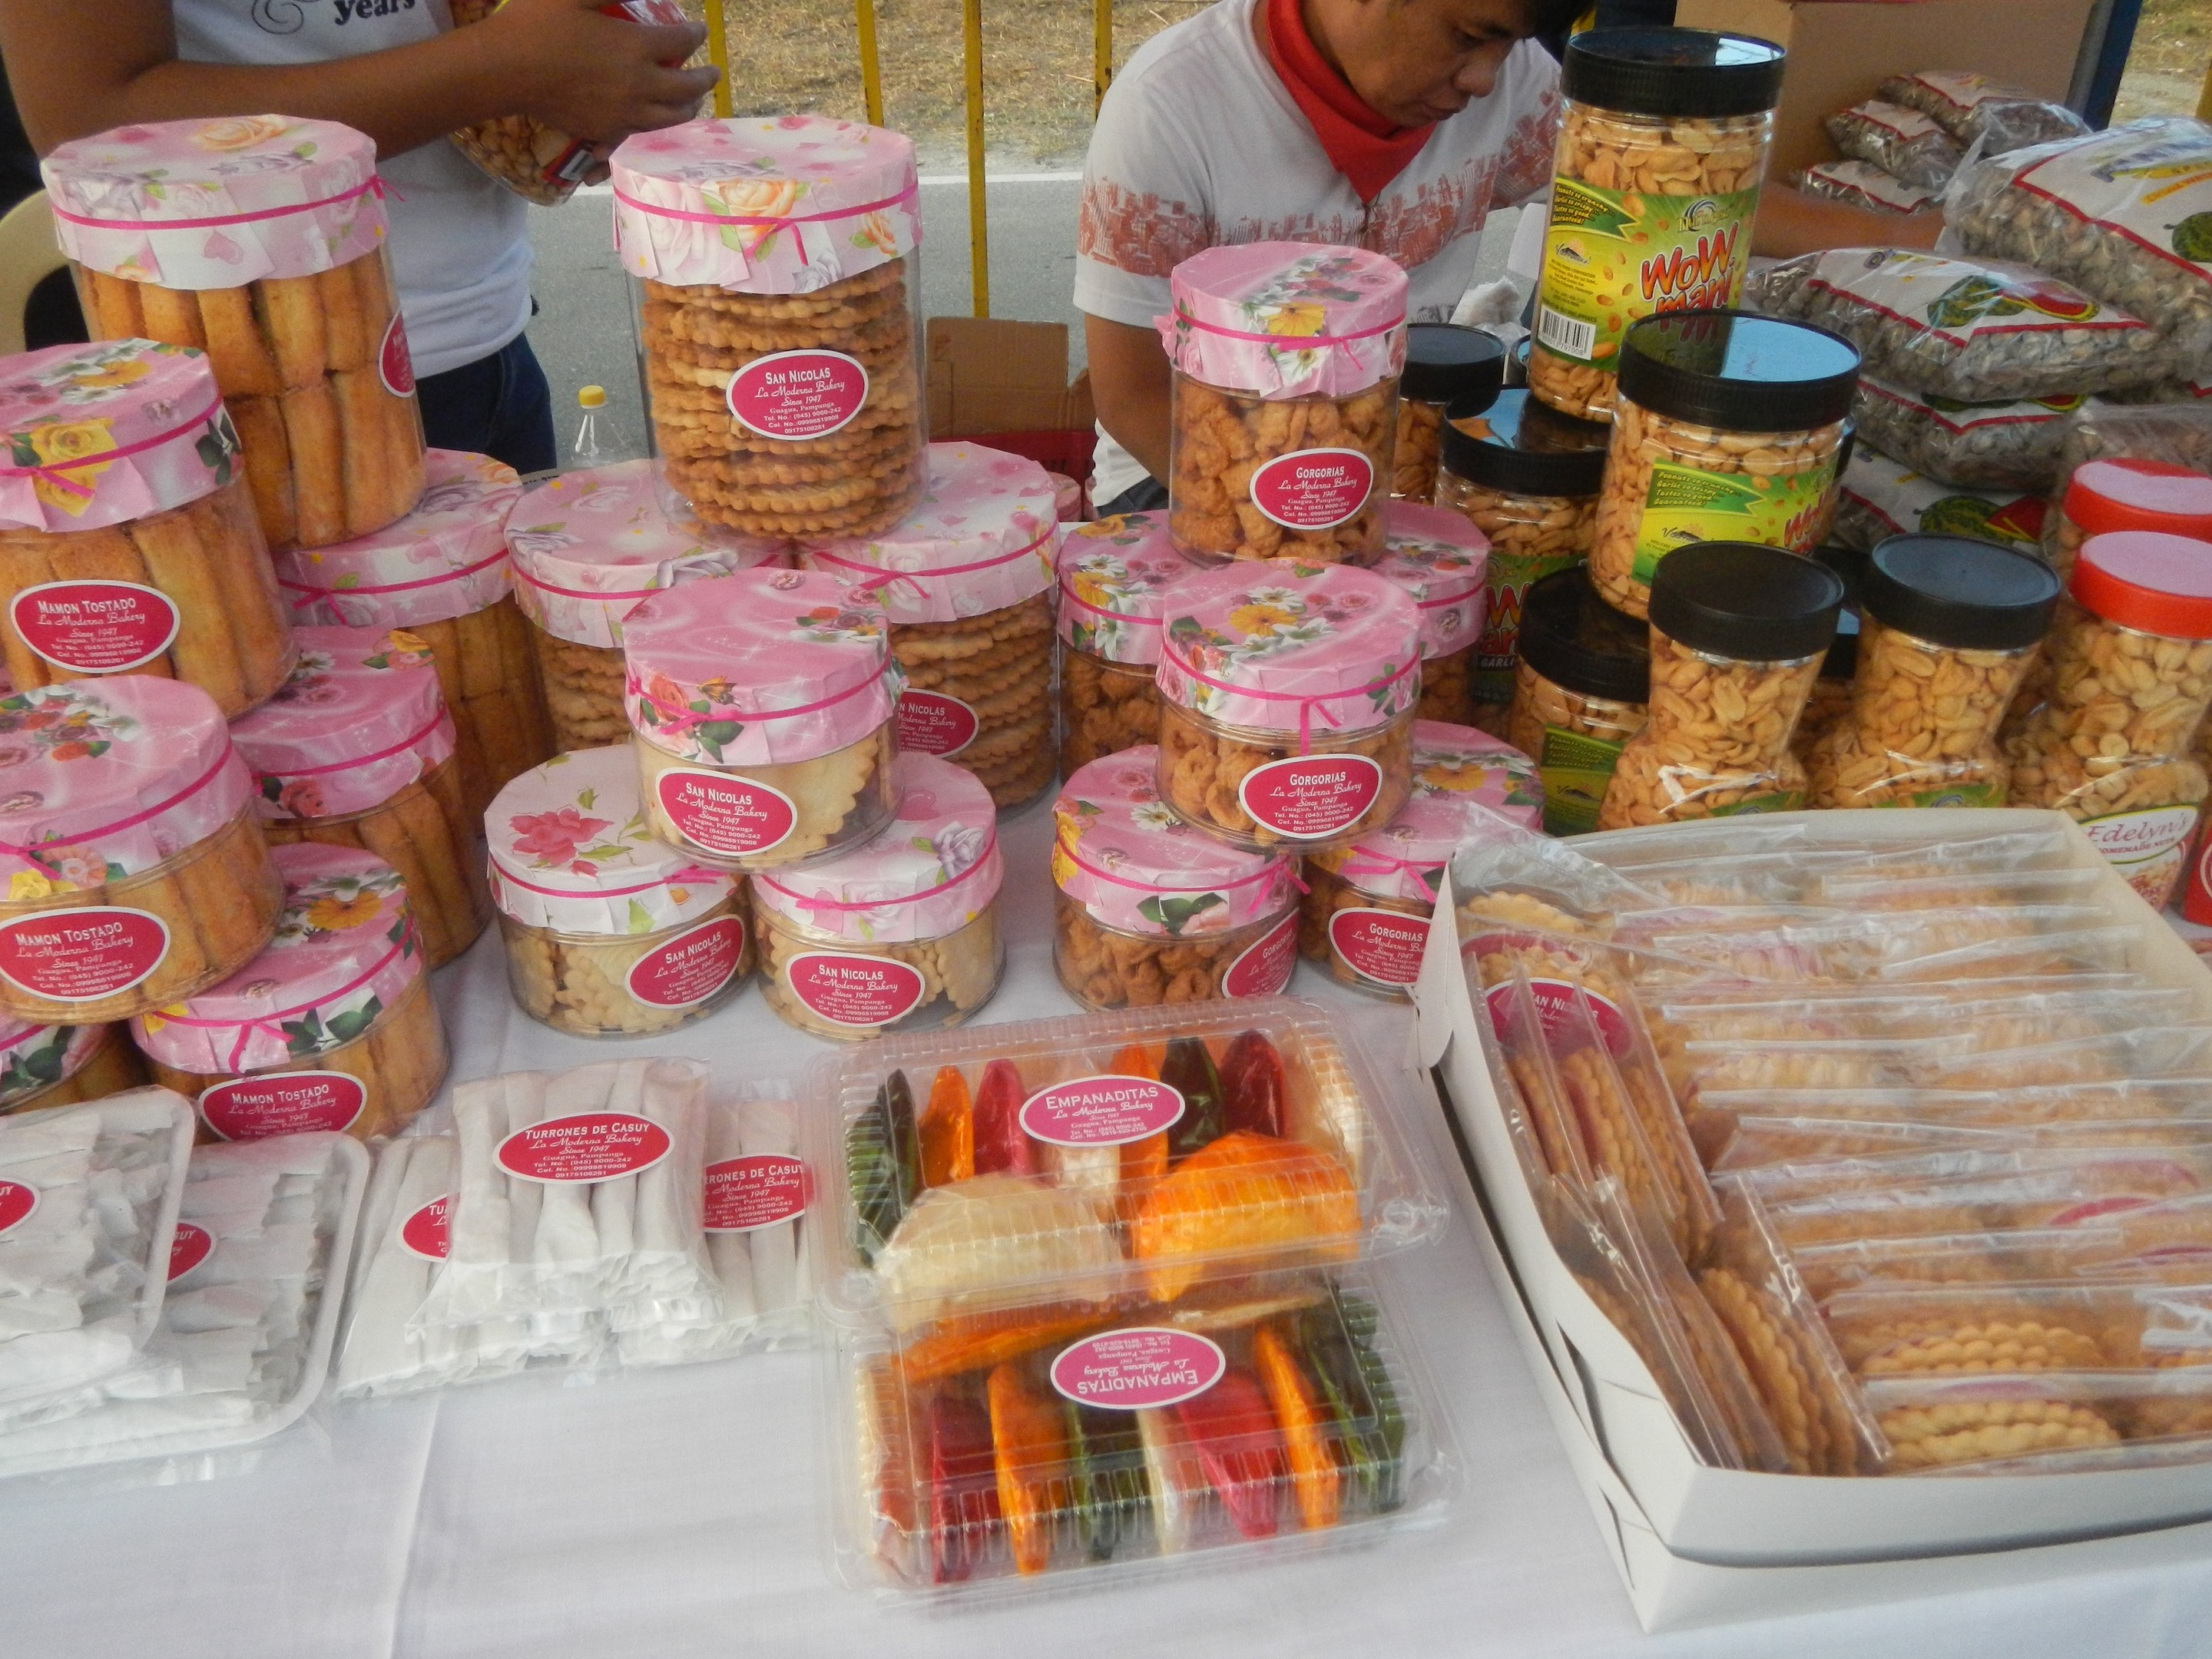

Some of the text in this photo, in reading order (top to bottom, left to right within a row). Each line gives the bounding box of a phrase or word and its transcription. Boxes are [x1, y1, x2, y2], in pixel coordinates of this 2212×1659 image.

[765, 368, 830, 385] SAN NICOLAS
[755, 379, 845, 398] La Moderna Bakery
[781, 395, 821, 406] Since 1947
[800, 402, 834, 411] Pampanga
[1296, 466, 1344, 478] GORGORIAS
[1659, 472, 1690, 482] Peanuts
[1278, 476, 1357, 490] La Moderna Bakery
[1300, 491, 1320, 499] Since
[1654, 498, 1706, 507] Guaranteed!
[38, 598, 136, 614] MAMON TOSTADO
[37, 610, 145, 626] La Moderna Bakery
[98, 628, 118, 636] 1947
[909, 703, 945, 715] NICOLAS
[929, 716, 955, 729] Bakery
[1290, 771, 1346, 786] GORGORIAS
[686, 782, 752, 805] SAN NICOLAS
[1270, 781, 1362, 797] La Moderna Bakery
[676, 793, 767, 821] La Moderna Bakery
[1296, 799, 1318, 807] Since
[698, 810, 740, 825] Since 1947
[15, 922, 123, 946] MAMON TOSTADO
[1353, 931, 1364, 940] La
[1367, 937, 1406, 950] Moderna
[1370, 923, 1422, 942] GORGORIAS
[17, 935, 134, 958] La Moderna Bakery
[666, 932, 720, 964] SAN NICOLAS
[1374, 947, 1393, 957] Since
[52, 954, 104, 968] Since 1947
[654, 967, 668, 978] La
[671, 955, 707, 973] Moderna
[818, 964, 883, 980] SAN NICOLAS
[808, 975, 898, 992] La Moderna Bakery
[832, 989, 852, 998] Since
[1533, 992, 1549, 1007] AN
[231, 1084, 329, 1104] MAMON TOSTADO
[1045, 1086, 1159, 1110] EMPANADITAS
[228, 1095, 336, 1114] La Moderna Bakery
[1053, 1102, 1153, 1119] La Moderna Bakery
[525, 1123, 650, 1139] TURRONES DE CASUY
[529, 1134, 642, 1149] La Moderna Bakery
[750, 1168, 764, 1177] DE
[769, 1164, 803, 1176] CASUY
[712, 1176, 800, 1194] Moderna Bakery
[1084, 1359, 1190, 1378] La Moderna Bakery
[1077, 1369, 1198, 1394] EMPANADITAS
